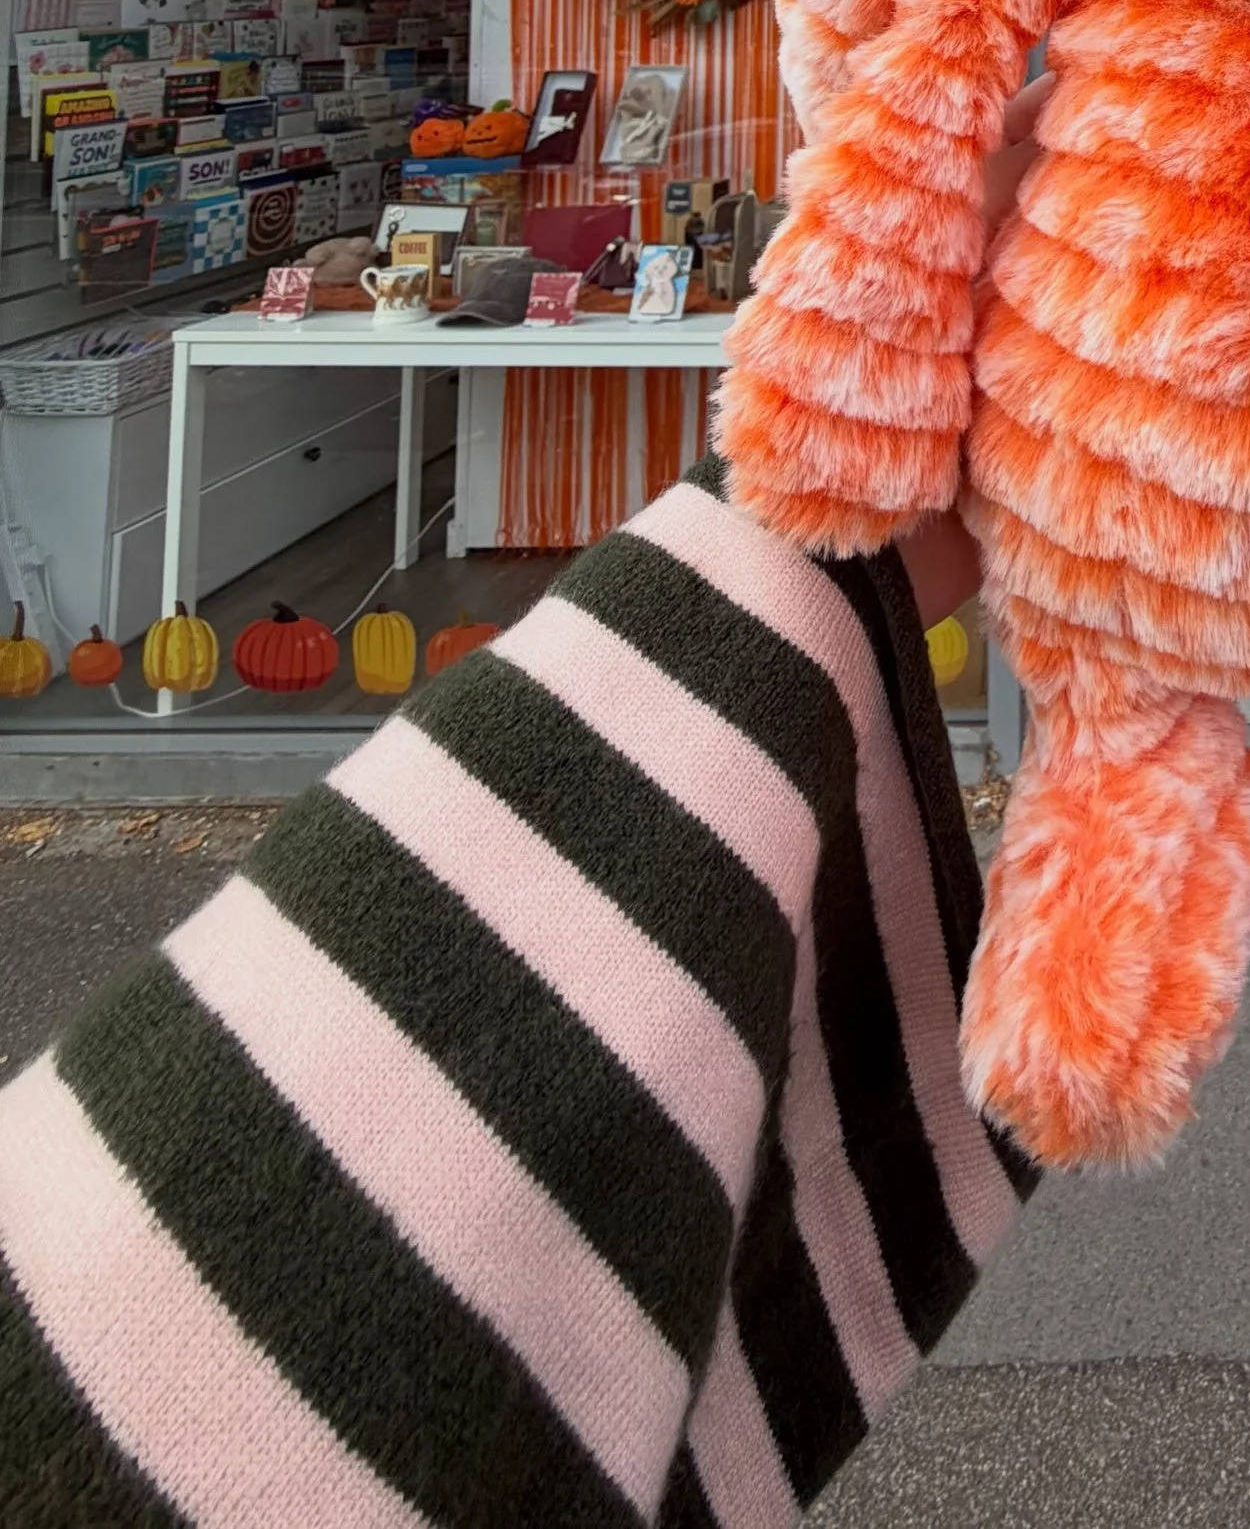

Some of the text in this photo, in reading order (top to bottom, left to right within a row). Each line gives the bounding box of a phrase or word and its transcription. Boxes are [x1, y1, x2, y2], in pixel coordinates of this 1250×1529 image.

[69, 143, 116, 166] SON!
[189, 158, 231, 181] SON!
[399, 241, 428, 255] COFFEE
